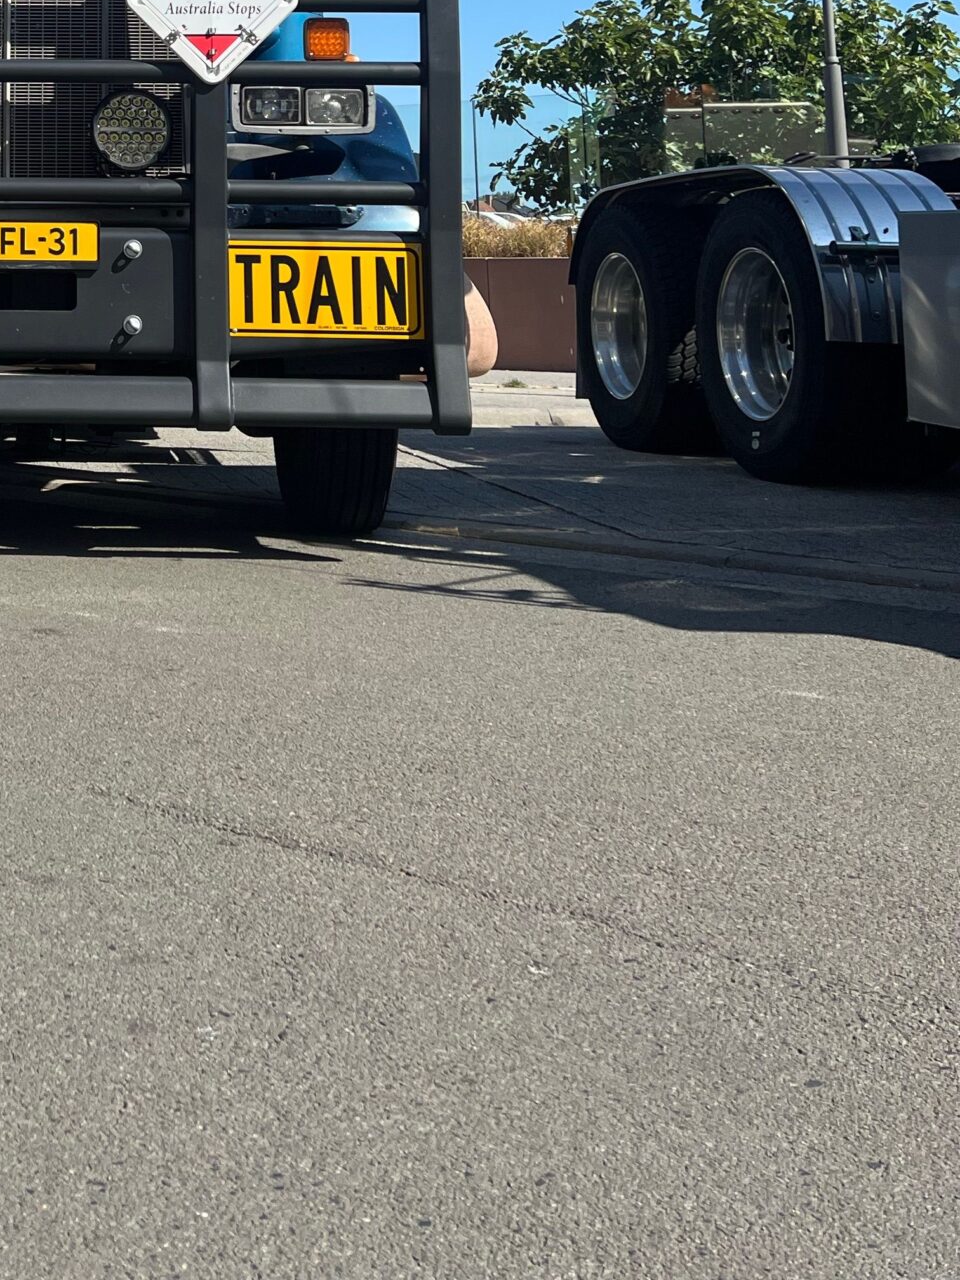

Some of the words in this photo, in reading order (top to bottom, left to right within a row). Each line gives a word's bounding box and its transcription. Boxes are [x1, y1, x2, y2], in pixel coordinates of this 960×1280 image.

[164, 1, 223, 15] Australia
[227, 1, 261, 18] Stops
[235, 254, 407, 325] TRAIN
